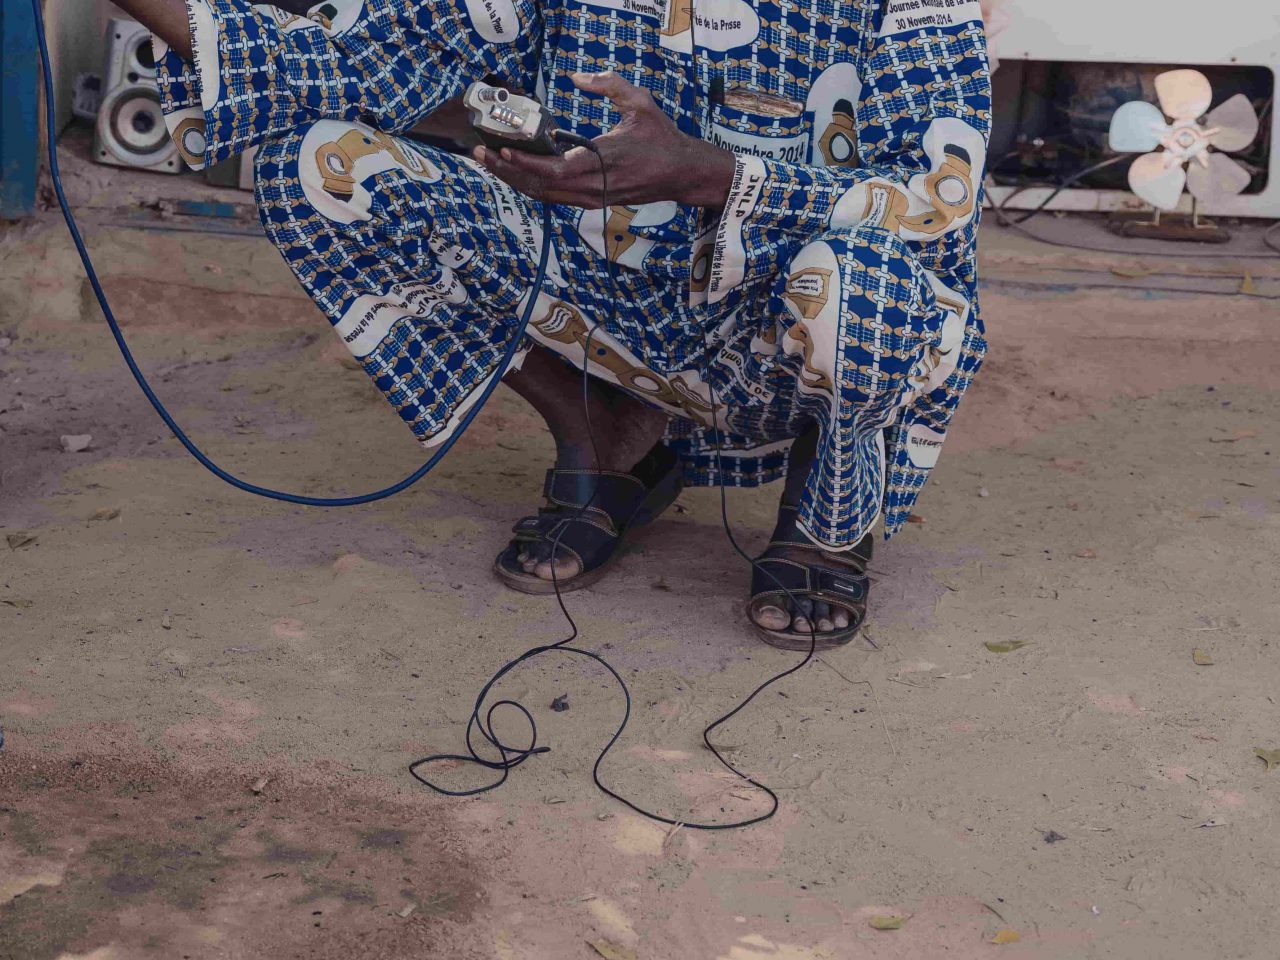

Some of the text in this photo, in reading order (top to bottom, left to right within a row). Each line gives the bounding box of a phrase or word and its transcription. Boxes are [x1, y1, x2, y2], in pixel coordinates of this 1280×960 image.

[711, 18, 719, 31] la
[896, 18, 906, 30] 30
[731, 159, 747, 190] Journée
[735, 174, 760, 218] JNLP
[345, 325, 366, 343] Presse
